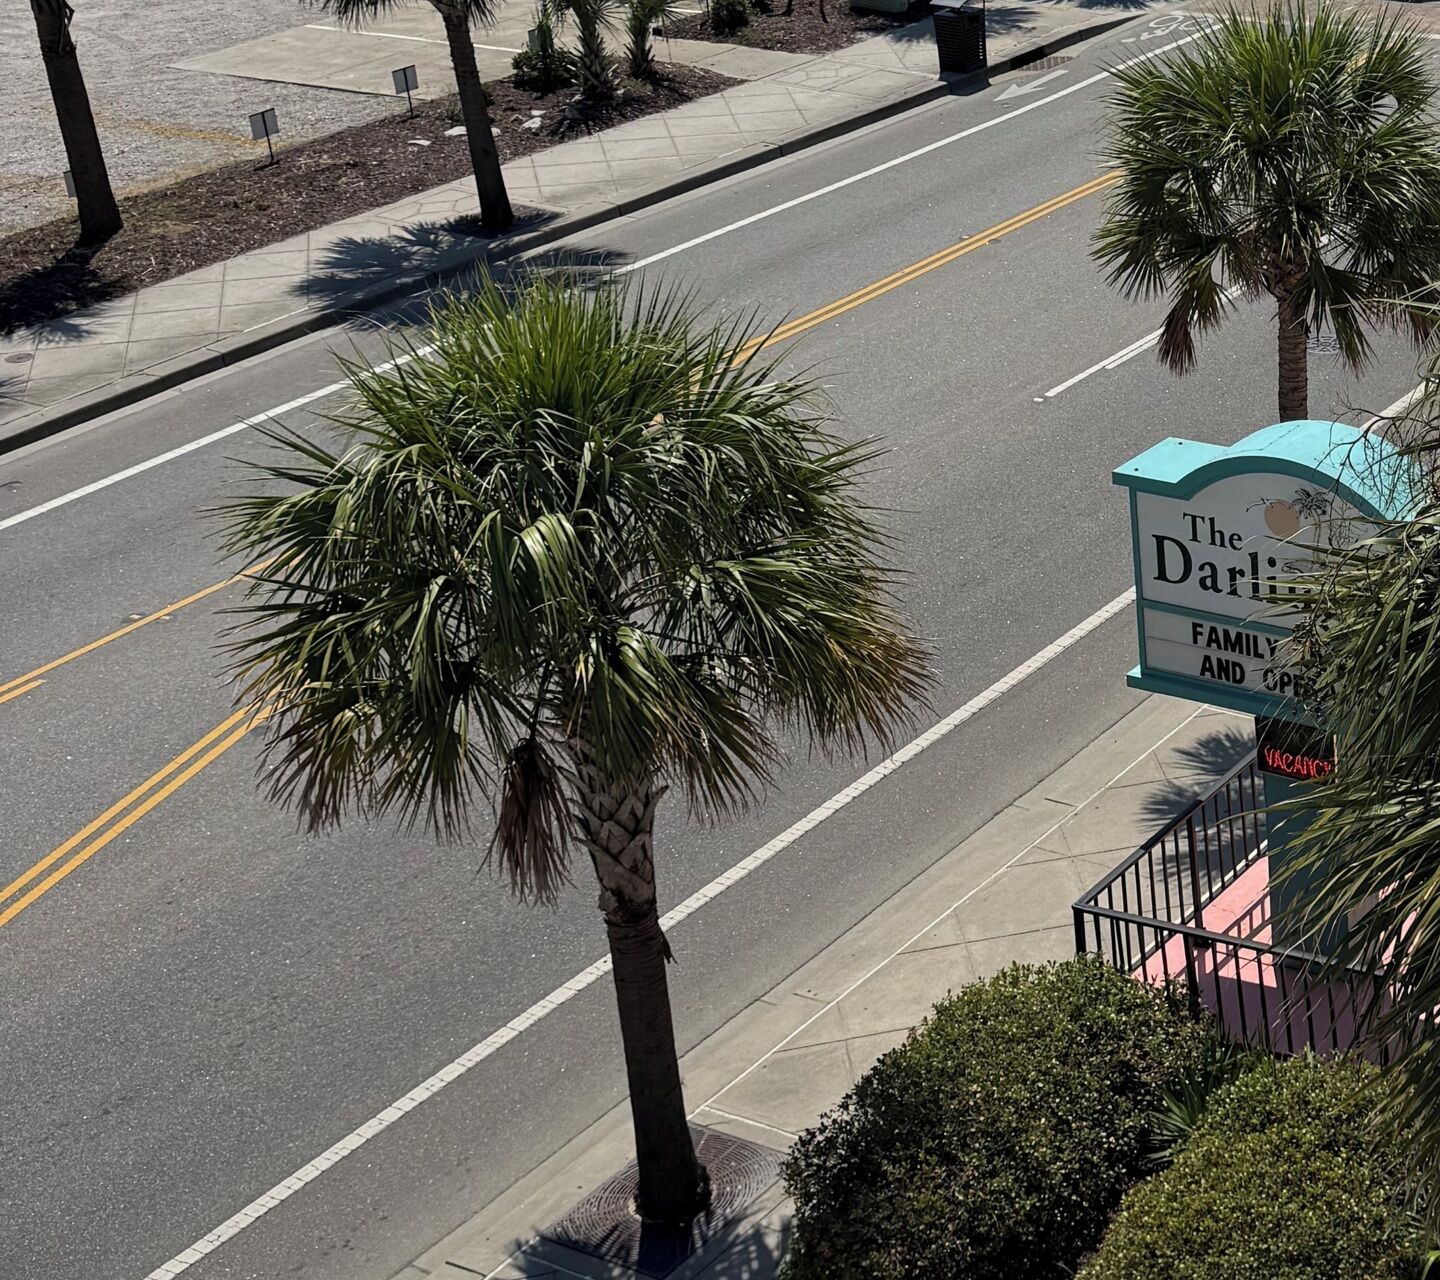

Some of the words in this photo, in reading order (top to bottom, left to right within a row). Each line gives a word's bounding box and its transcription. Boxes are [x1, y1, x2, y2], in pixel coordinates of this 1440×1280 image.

[1182, 512, 1243, 551] The
[1192, 622, 1279, 659] FAMILY
[1200, 655, 1245, 684] AND
[1264, 745, 1332, 779] VACANCY
